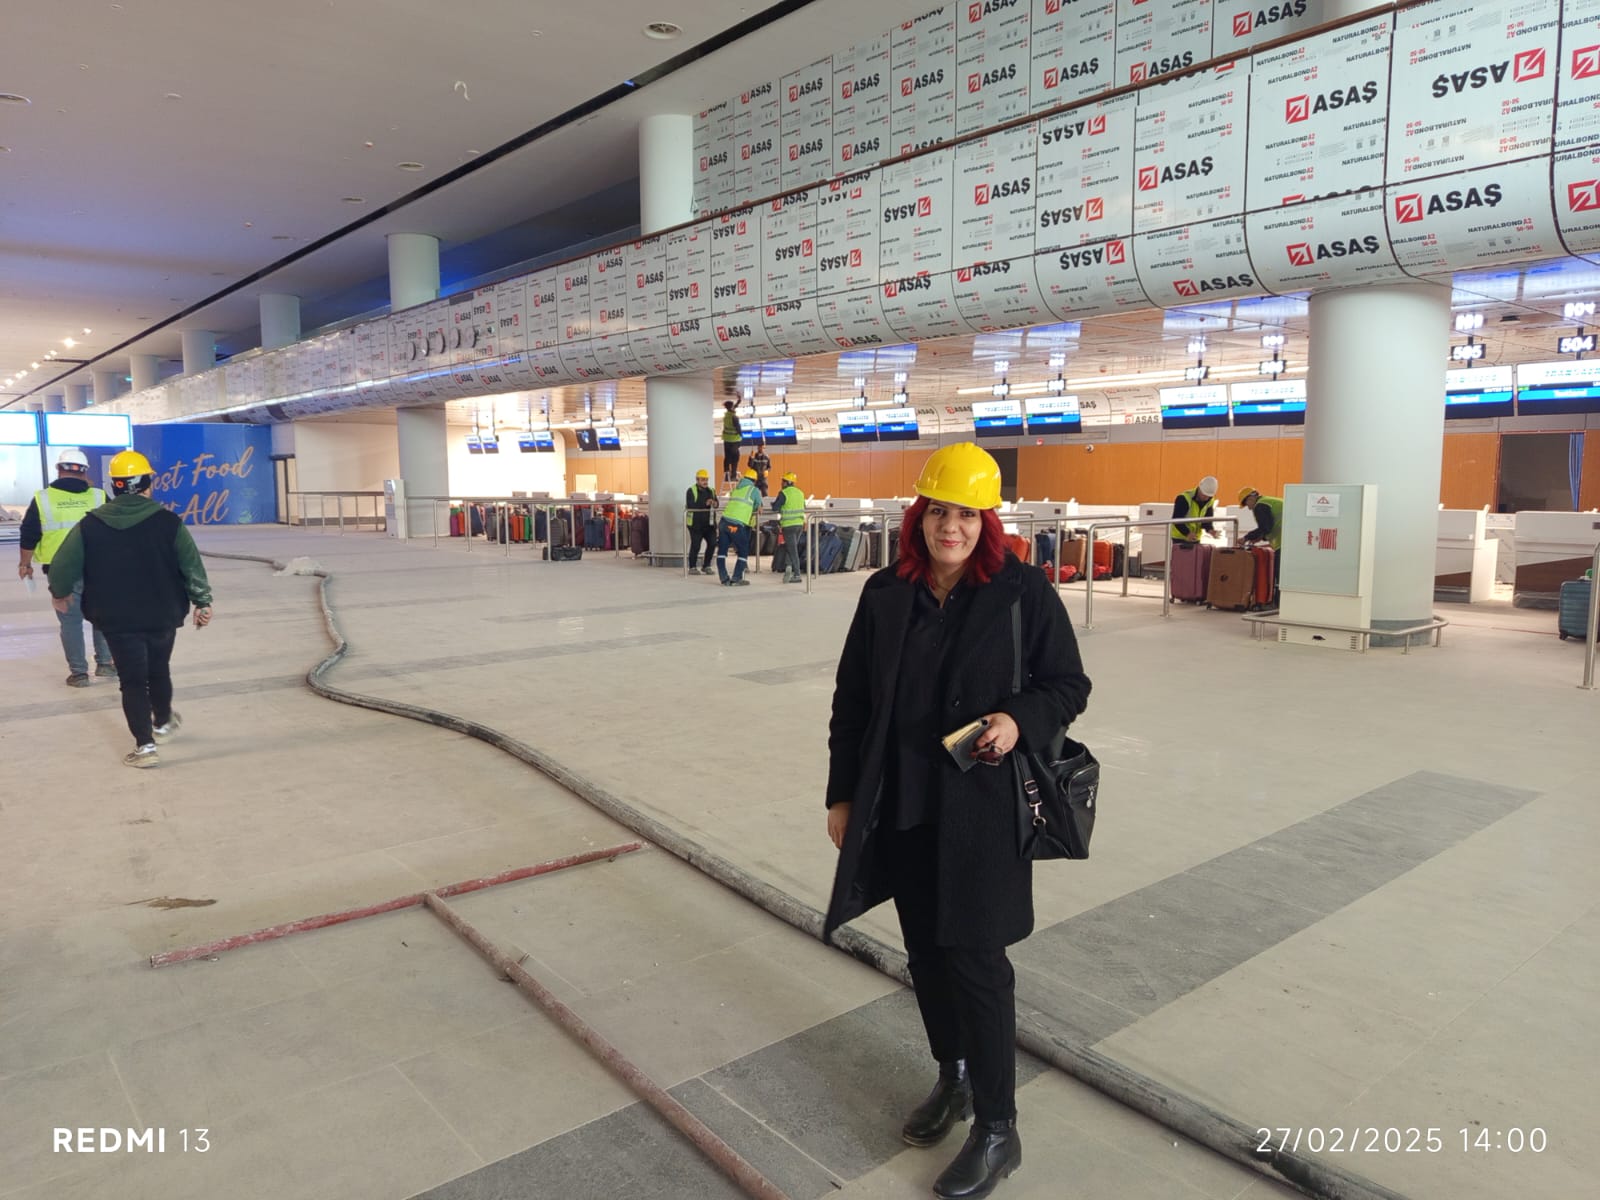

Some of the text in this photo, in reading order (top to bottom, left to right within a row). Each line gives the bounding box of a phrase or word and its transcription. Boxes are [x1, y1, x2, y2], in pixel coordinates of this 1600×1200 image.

[1255, 0, 1307, 28] ASAŞ
[1418, 43, 1472, 63] NATURALBOND
[914, 69, 944, 91] ASAŞ
[982, 64, 1016, 87] ASAŞ
[1060, 57, 1099, 82] ASAŞ
[1432, 60, 1510, 99] ASAŞ
[799, 78, 823, 97] ASAŞ
[853, 73, 880, 93] ASAŞ
[1312, 81, 1378, 114] ASAŞ
[1414, 117, 1467, 135] NATURALBOND
[750, 139, 772, 156] ASAŞ
[799, 139, 823, 156] ASAŞ
[853, 137, 880, 156] ASAŞ
[708, 152, 728, 166] ASAŞ
[1160, 156, 1214, 184] ASAŞ
[1412, 154, 1465, 171] NATURALBOND
[991, 177, 1031, 200] ASAŞ
[1427, 183, 1503, 215] ASAŞ
[884, 202, 917, 223] ASAŞ
[1041, 204, 1084, 228] ASAŞ
[1467, 219, 1523, 233] NATURALBOND
[1060, 247, 1104, 270] ASAŞ
[1317, 235, 1380, 260] ASAŞ
[820, 253, 848, 271] ASAŞ
[899, 276, 931, 293] ASAŞ
[151, 446, 254, 492] est Food
[178, 489, 230, 525] All
